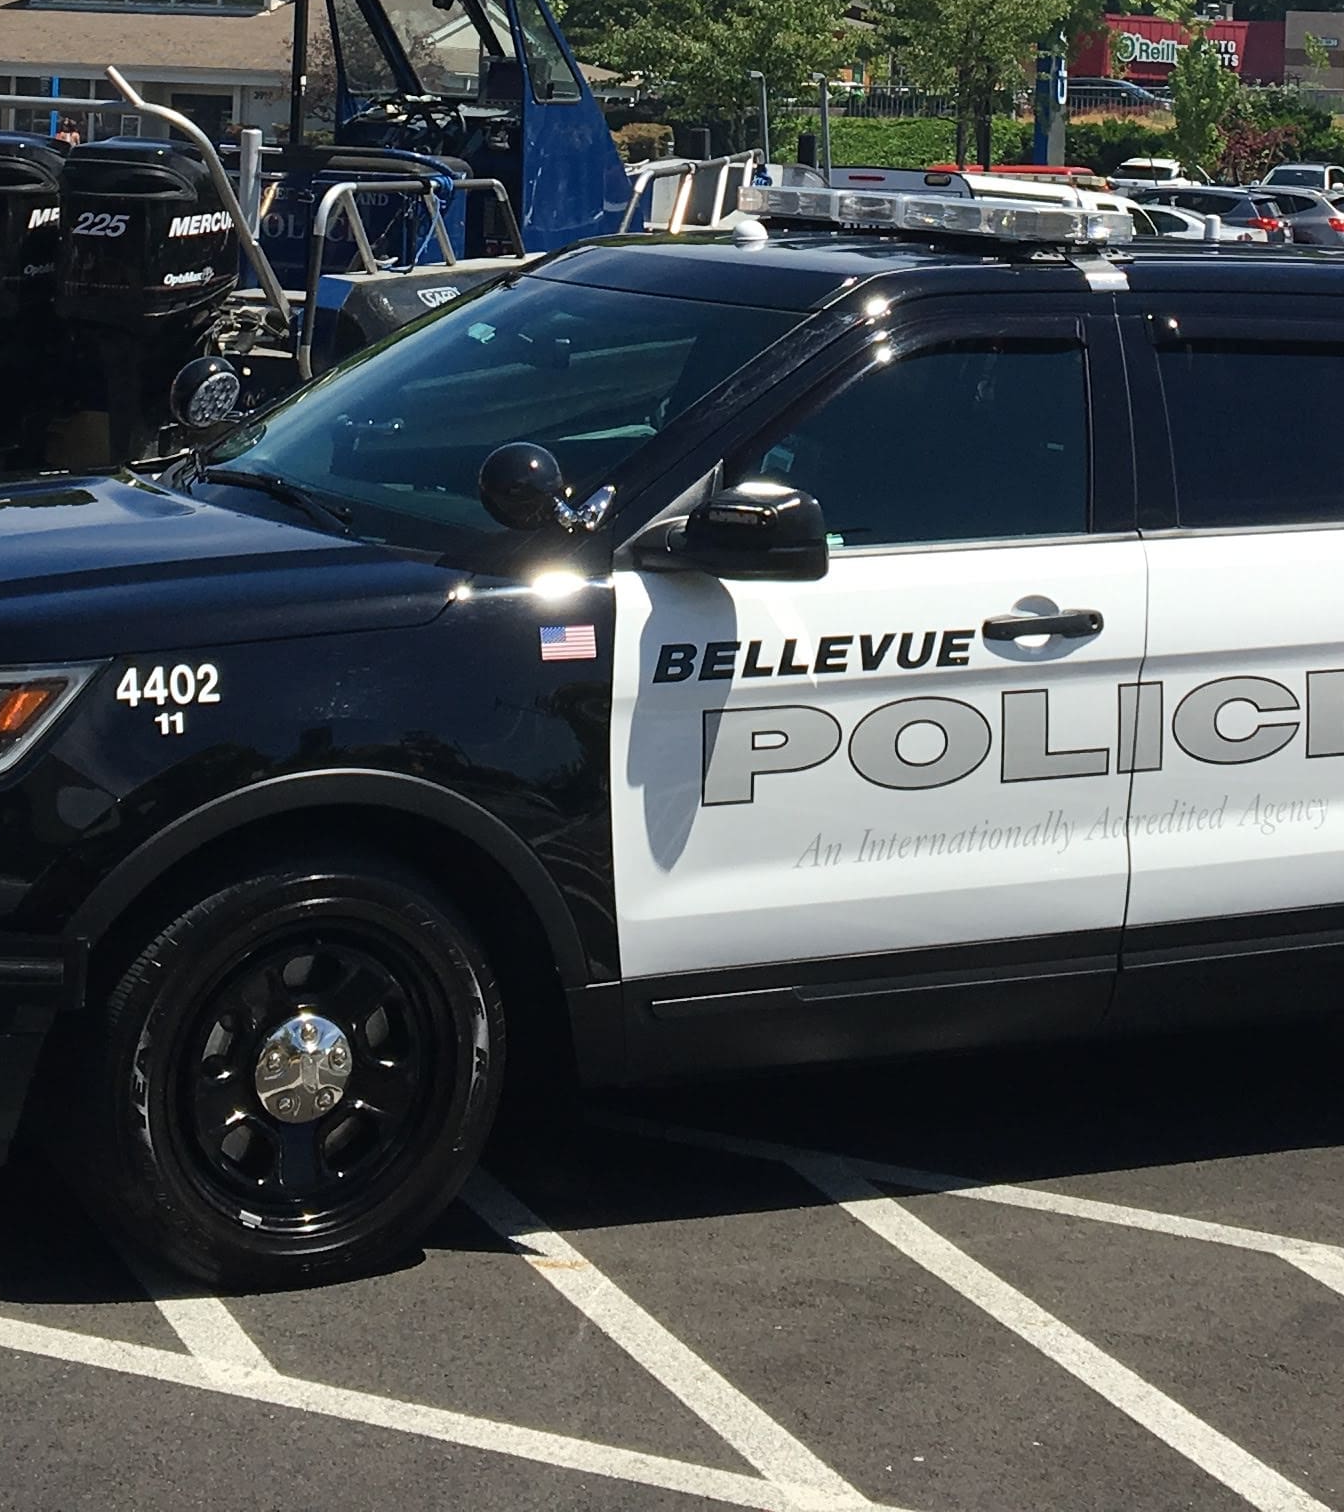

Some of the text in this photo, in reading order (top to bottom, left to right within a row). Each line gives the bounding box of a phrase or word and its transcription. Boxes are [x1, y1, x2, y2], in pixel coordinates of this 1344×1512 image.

[1116, 33, 1177, 64] O'Reill
[73, 213, 130, 237] 225
[168, 211, 235, 238] MERCU
[652, 630, 976, 684] BELLEVUE
[116, 663, 221, 707] 4402
[154, 711, 184, 735] 11
[792, 793, 1330, 869] An Internationally Accredited Agency
